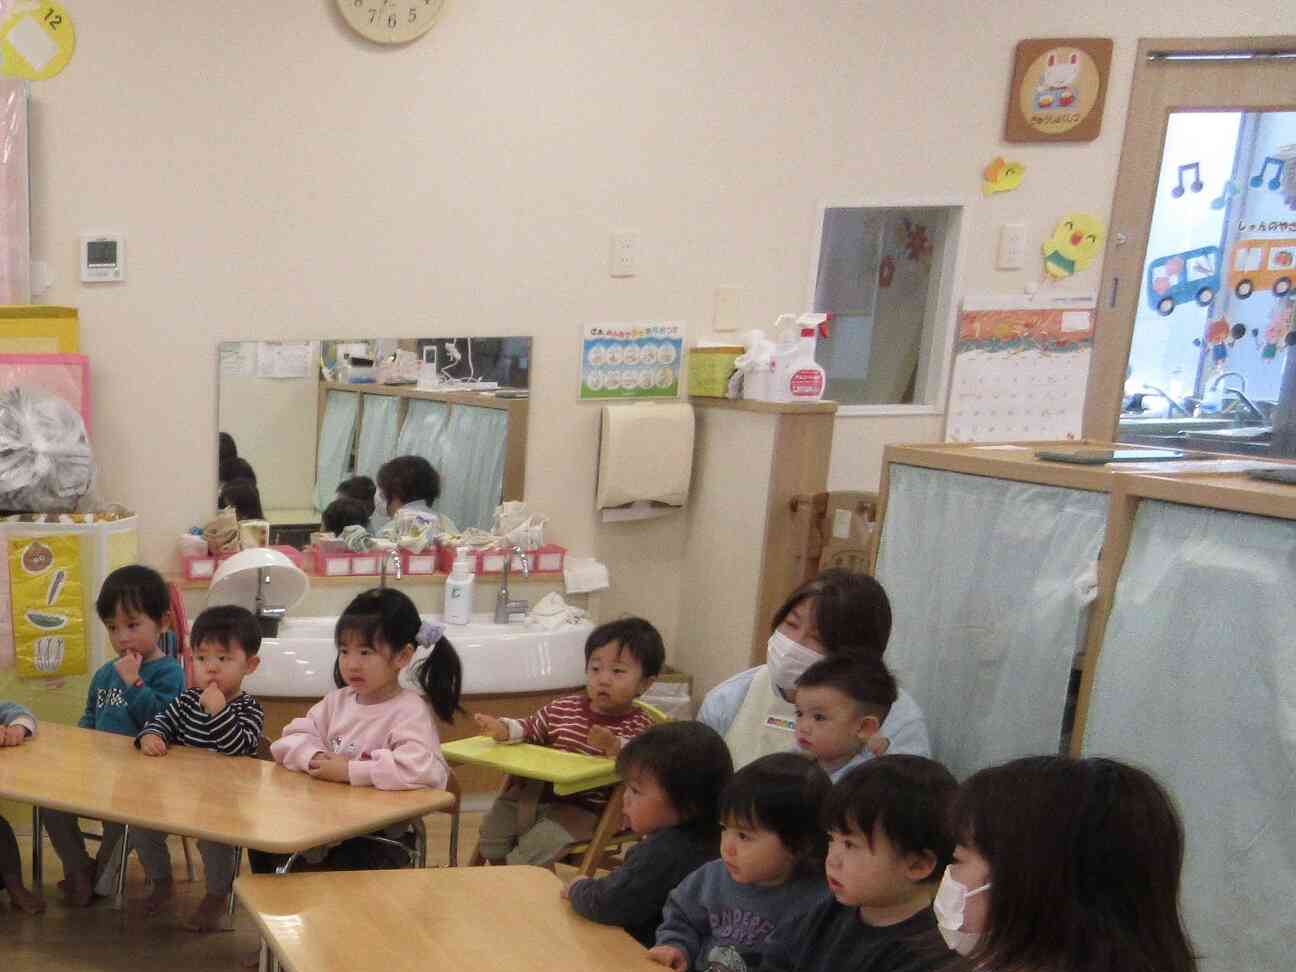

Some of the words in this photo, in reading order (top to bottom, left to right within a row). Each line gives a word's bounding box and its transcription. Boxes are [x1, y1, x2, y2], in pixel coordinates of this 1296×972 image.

[44, 8, 62, 31] 12
[368, 8, 377, 24] 7
[387, 12, 397, 29] 6
[408, 8, 417, 24] 5
